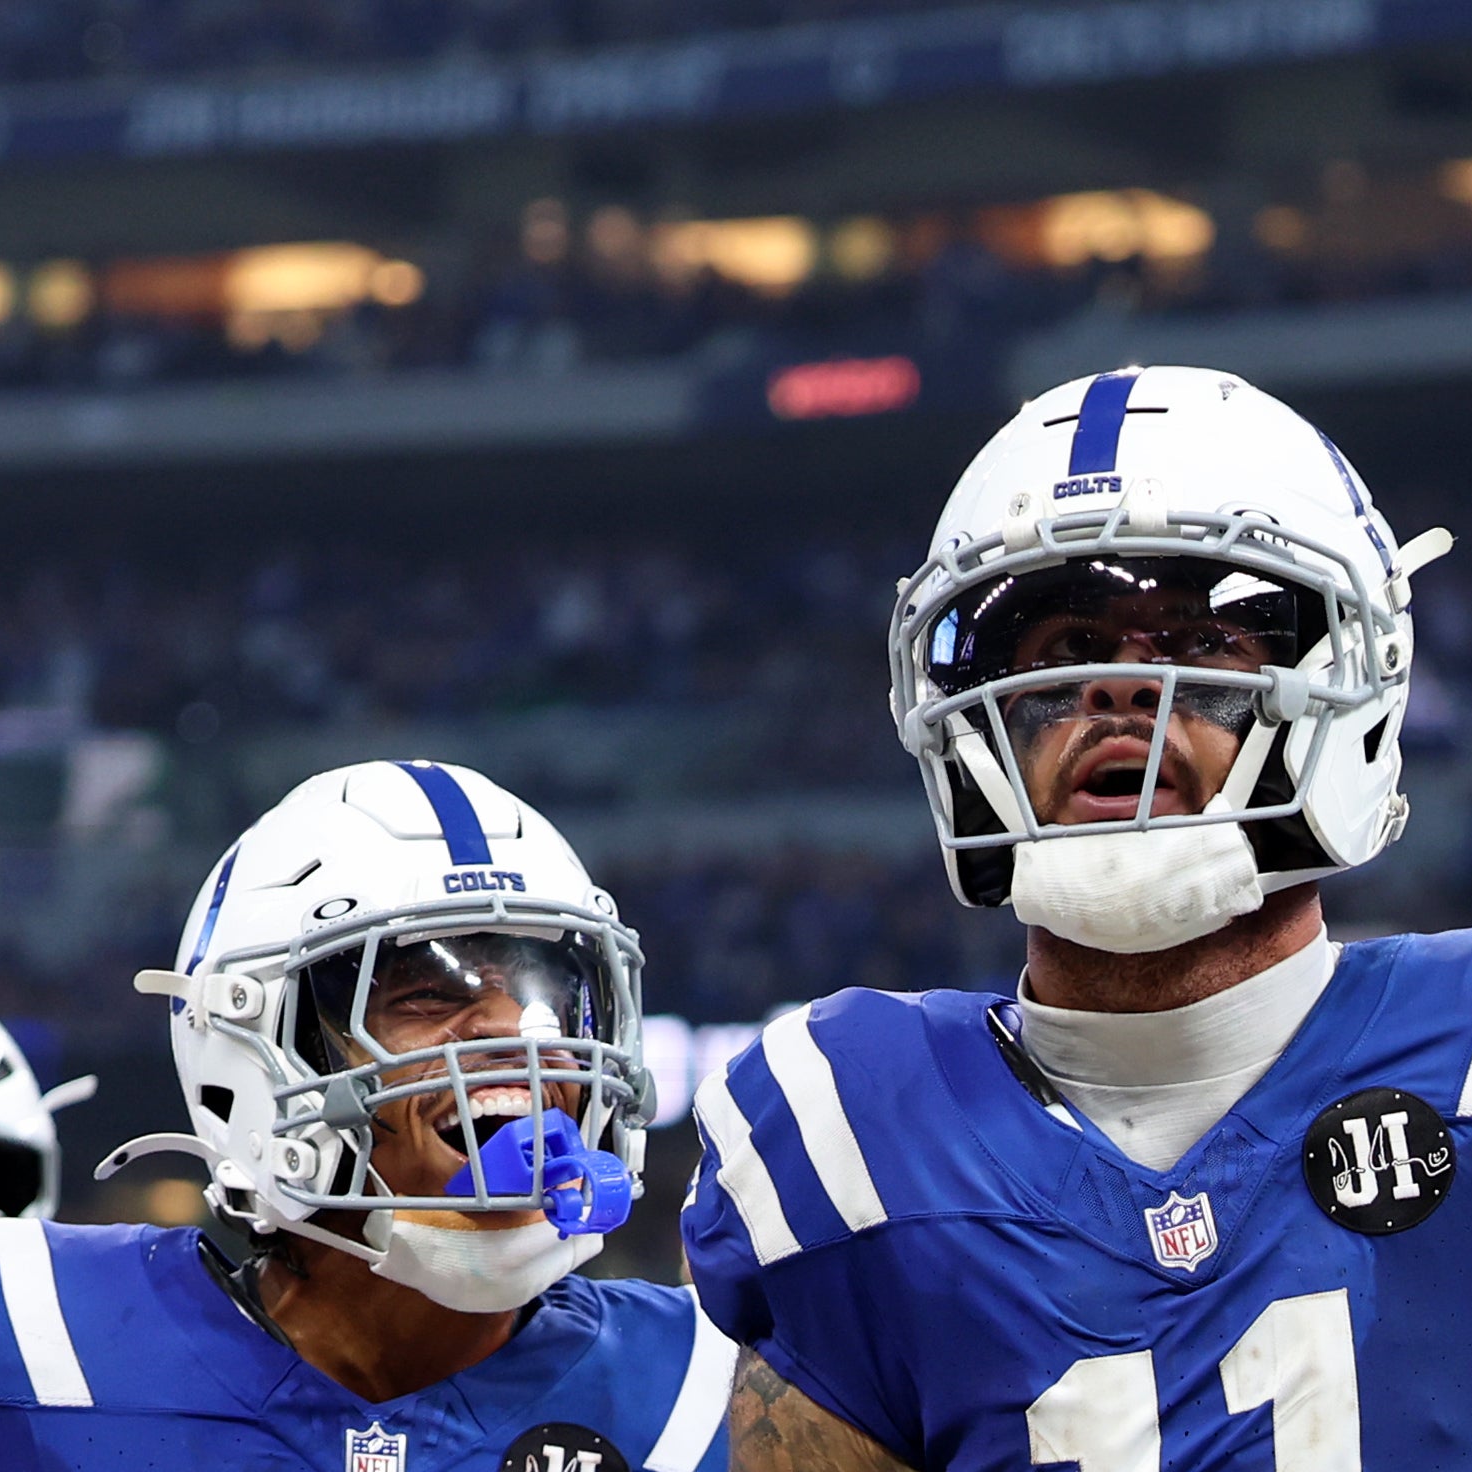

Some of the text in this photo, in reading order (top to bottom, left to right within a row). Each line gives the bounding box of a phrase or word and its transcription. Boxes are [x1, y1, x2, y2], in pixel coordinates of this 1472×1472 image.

[1052, 475, 1123, 499] COLTS
[443, 871, 526, 894] COLTS
[1160, 1223, 1206, 1257] NFL
